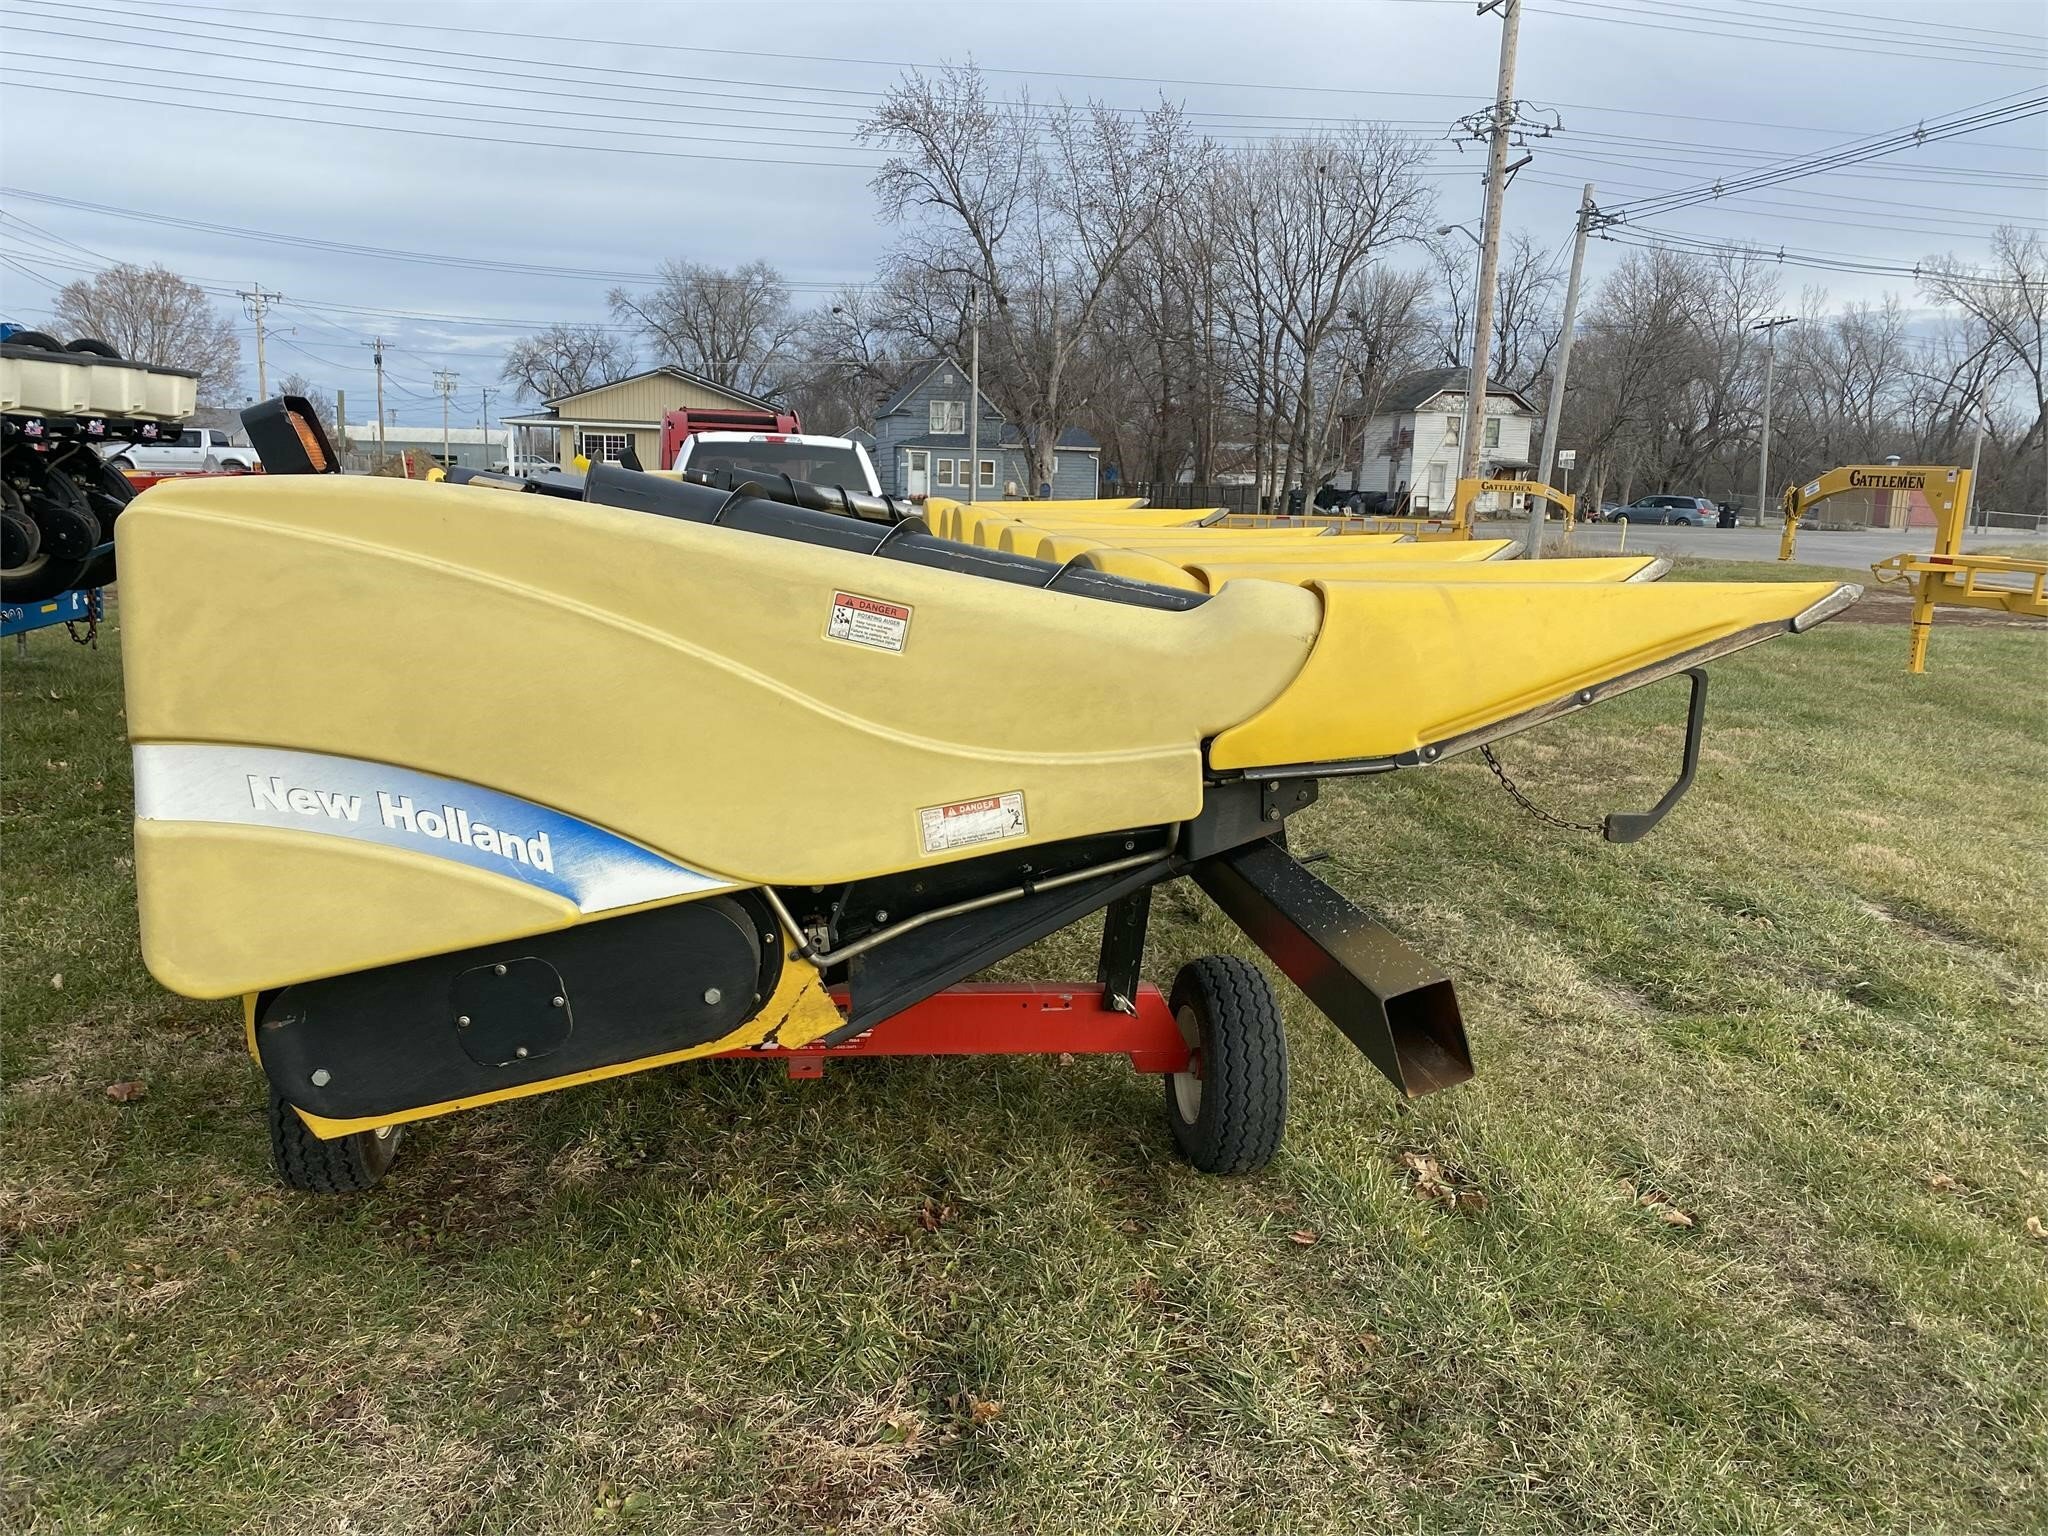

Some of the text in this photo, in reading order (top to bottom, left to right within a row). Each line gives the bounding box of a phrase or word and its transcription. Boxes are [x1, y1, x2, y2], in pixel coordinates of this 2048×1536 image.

[1481, 481, 1532, 492] CATTLEMEN
[1850, 469, 1926, 489] CATTLEMEN
[859, 601, 897, 616] DANGER
[960, 801, 995, 813] DANGER
[246, 774, 554, 874] New Holland
